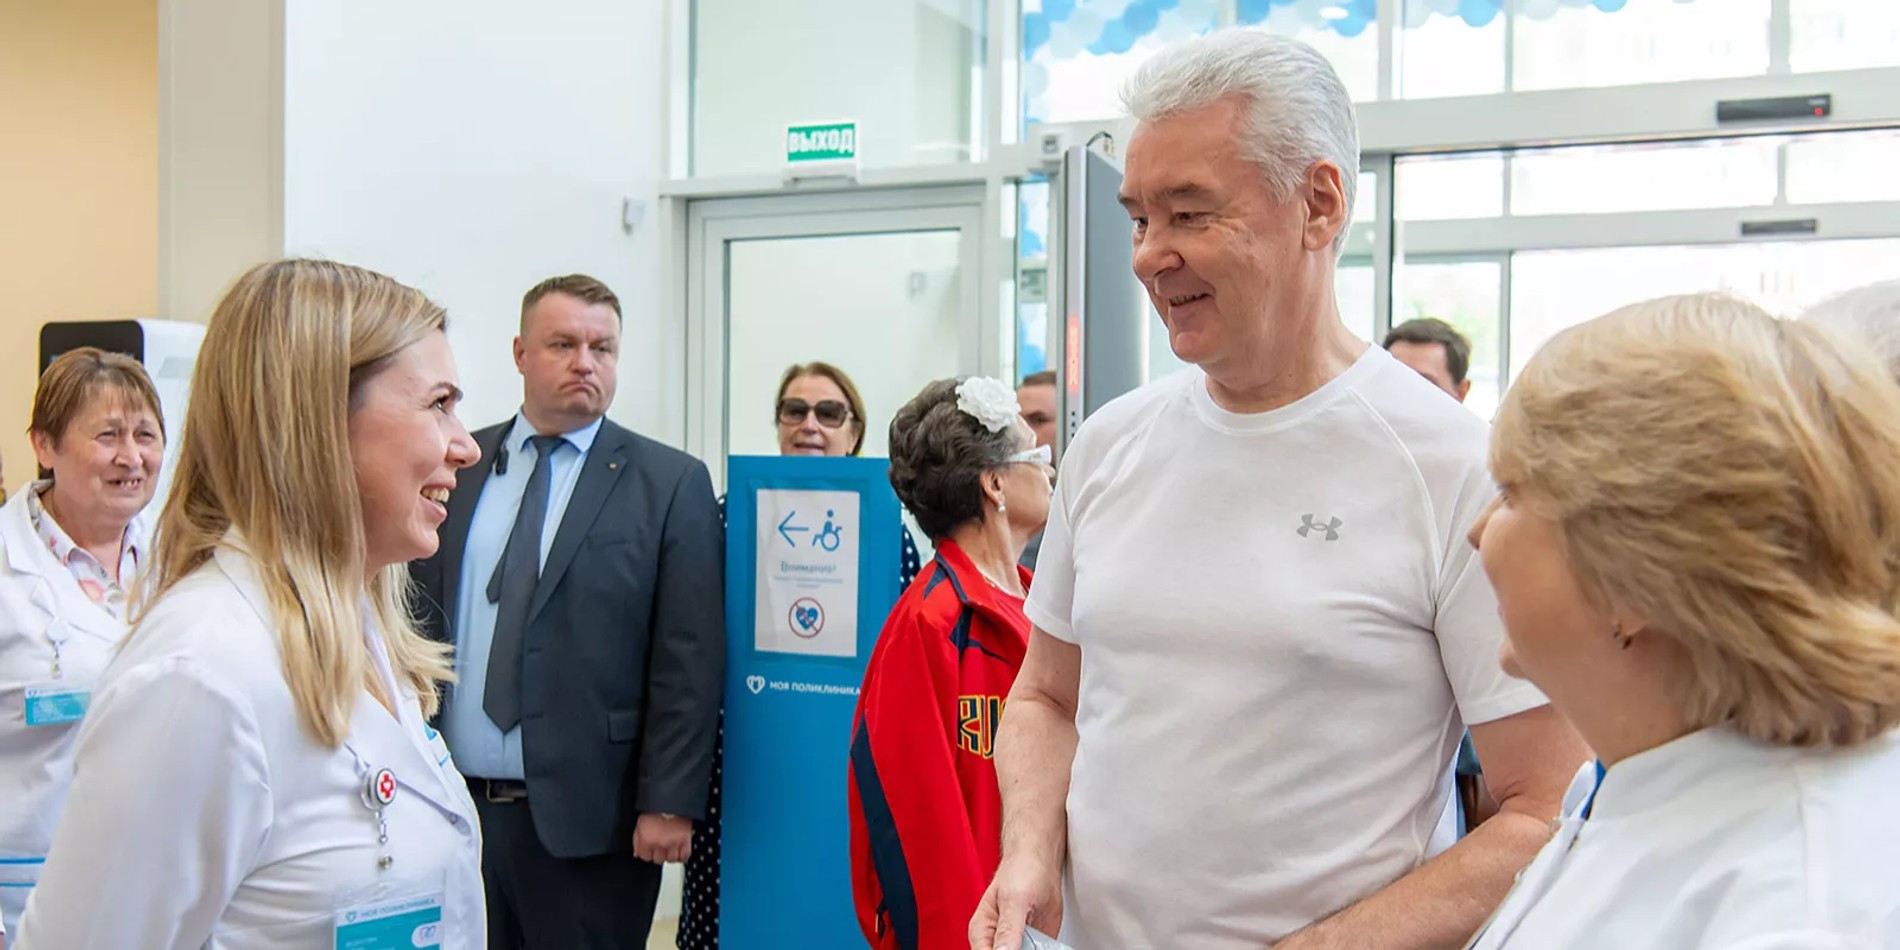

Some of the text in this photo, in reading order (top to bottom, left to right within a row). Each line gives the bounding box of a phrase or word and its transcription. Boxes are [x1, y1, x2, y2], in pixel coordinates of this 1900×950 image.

[789, 128, 854, 153] ВЫХОД
[769, 681, 861, 696] МОЯ ПОЛИКЛИНИКА
[957, 694, 1008, 759] RU
